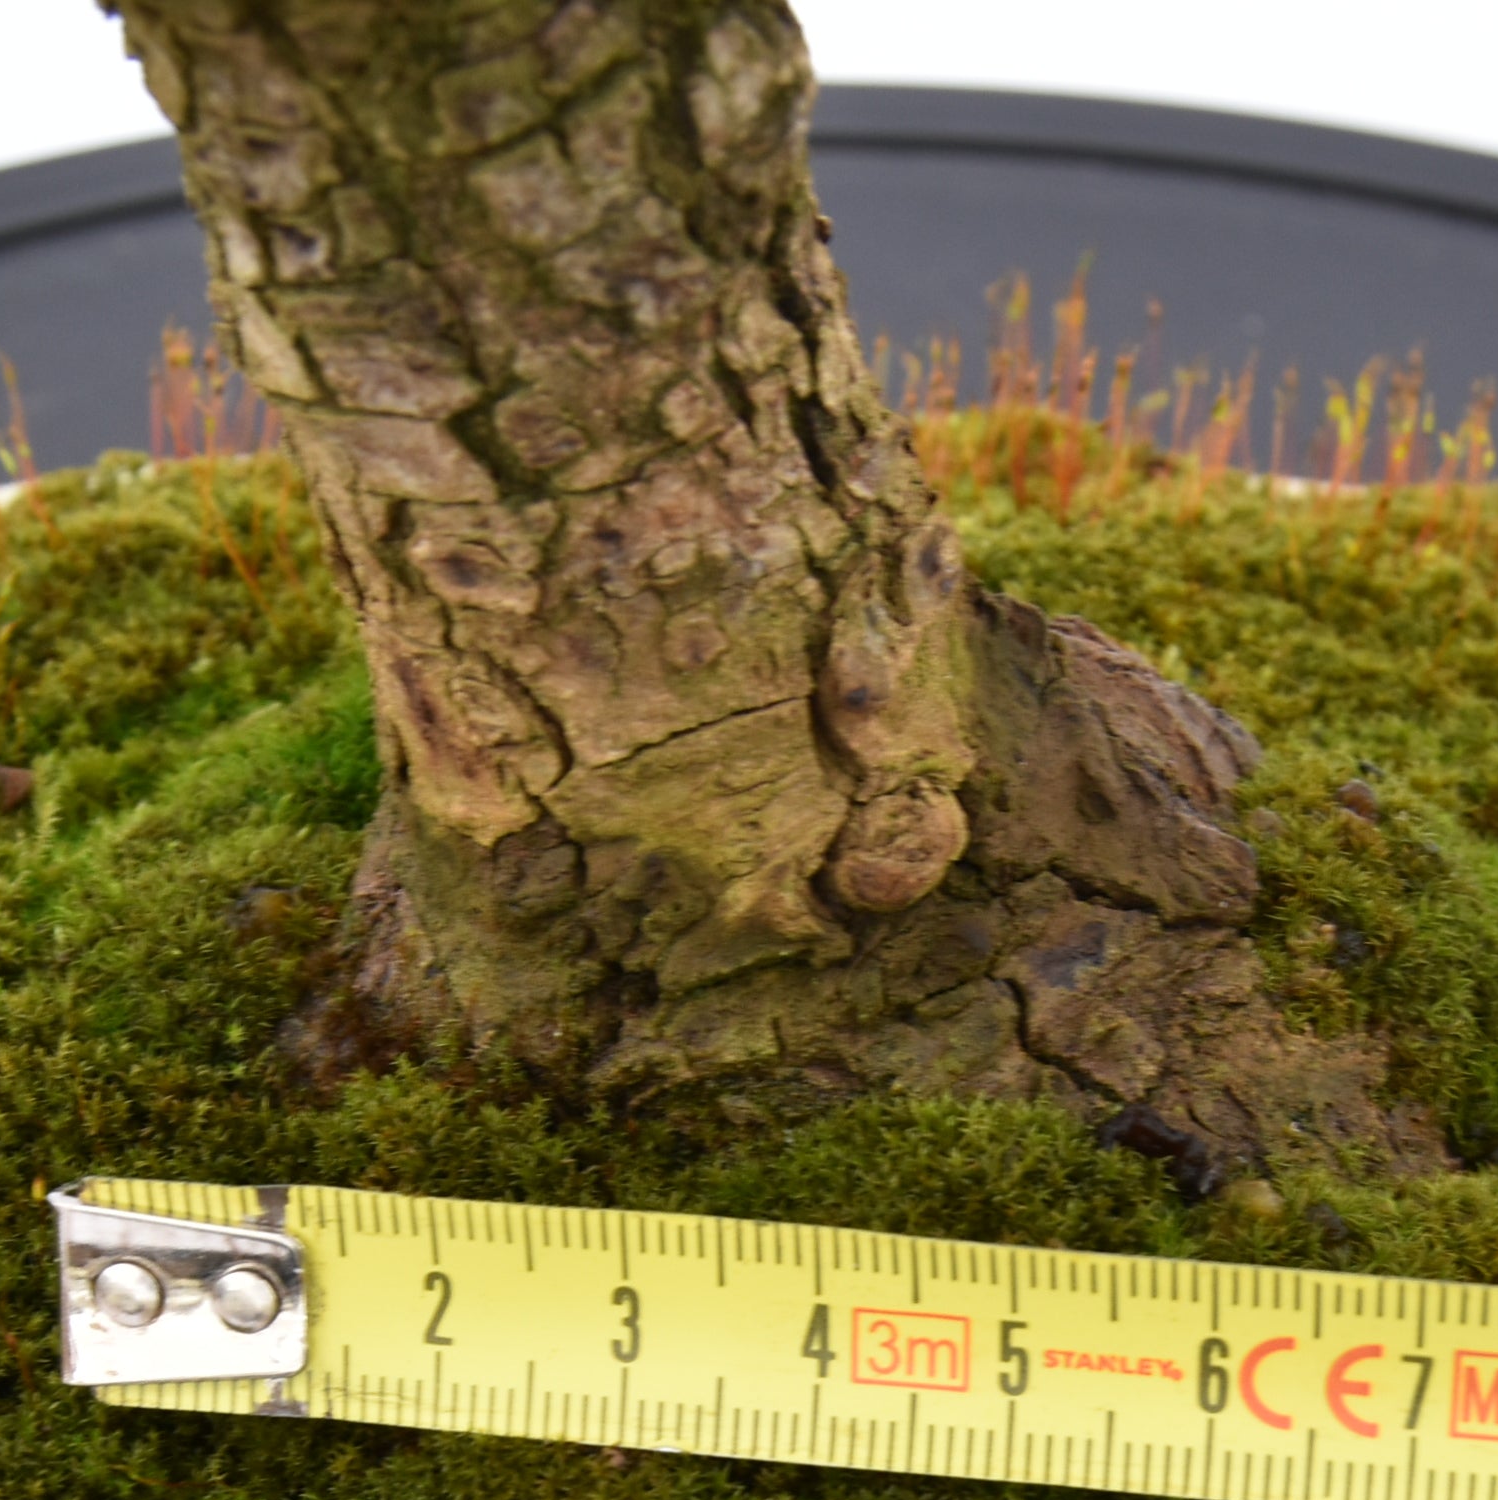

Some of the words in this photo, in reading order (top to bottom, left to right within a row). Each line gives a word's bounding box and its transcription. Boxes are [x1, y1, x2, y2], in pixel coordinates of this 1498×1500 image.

[424, 1271, 452, 1345] 2
[612, 1286, 640, 1362] 3
[802, 1303, 835, 1377] 4
[866, 1319, 958, 1380] 3m
[1000, 1320, 1029, 1396] 5
[1199, 1337, 1229, 1413] 6
[1239, 1336, 1385, 1438] CE
[1401, 1355, 1434, 1429] 7
